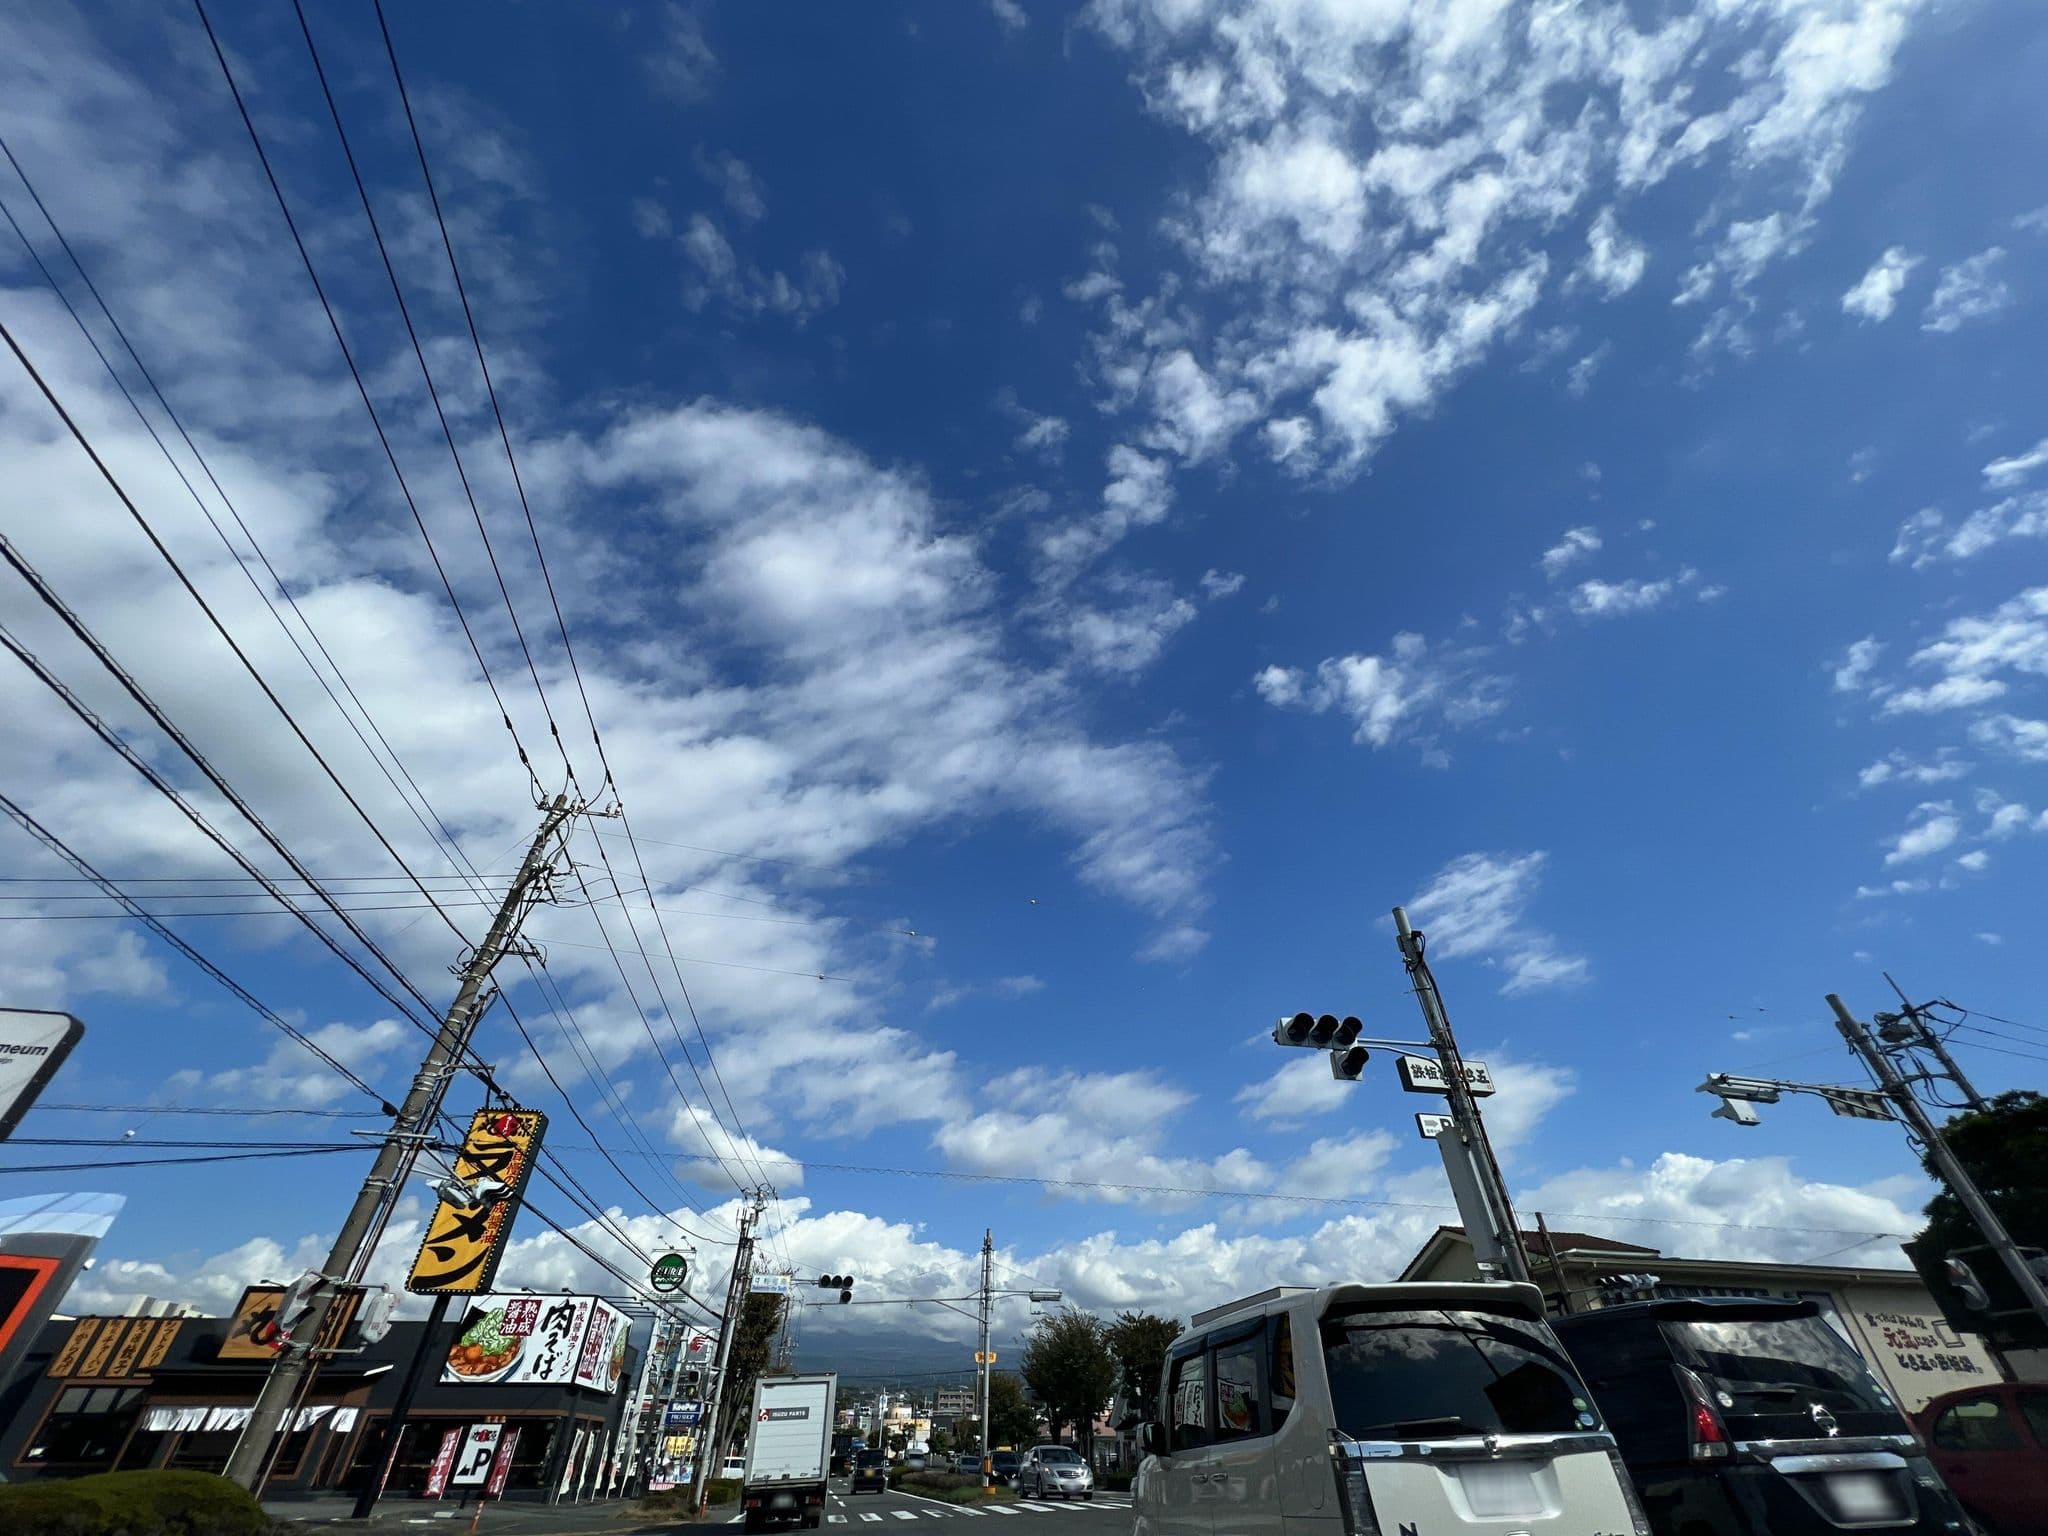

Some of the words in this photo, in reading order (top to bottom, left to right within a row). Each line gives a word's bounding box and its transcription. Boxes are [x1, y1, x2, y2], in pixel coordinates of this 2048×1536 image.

[480, 1149, 523, 1245] 自慢の成醤油
[500, 1301, 522, 1334] 醤油
[516, 1301, 538, 1334] 熟成
[532, 1299, 576, 1381] 肉そば
[559, 1301, 588, 1377] 熟成醤油ラーメン
[470, 1448, 492, 1476] P
